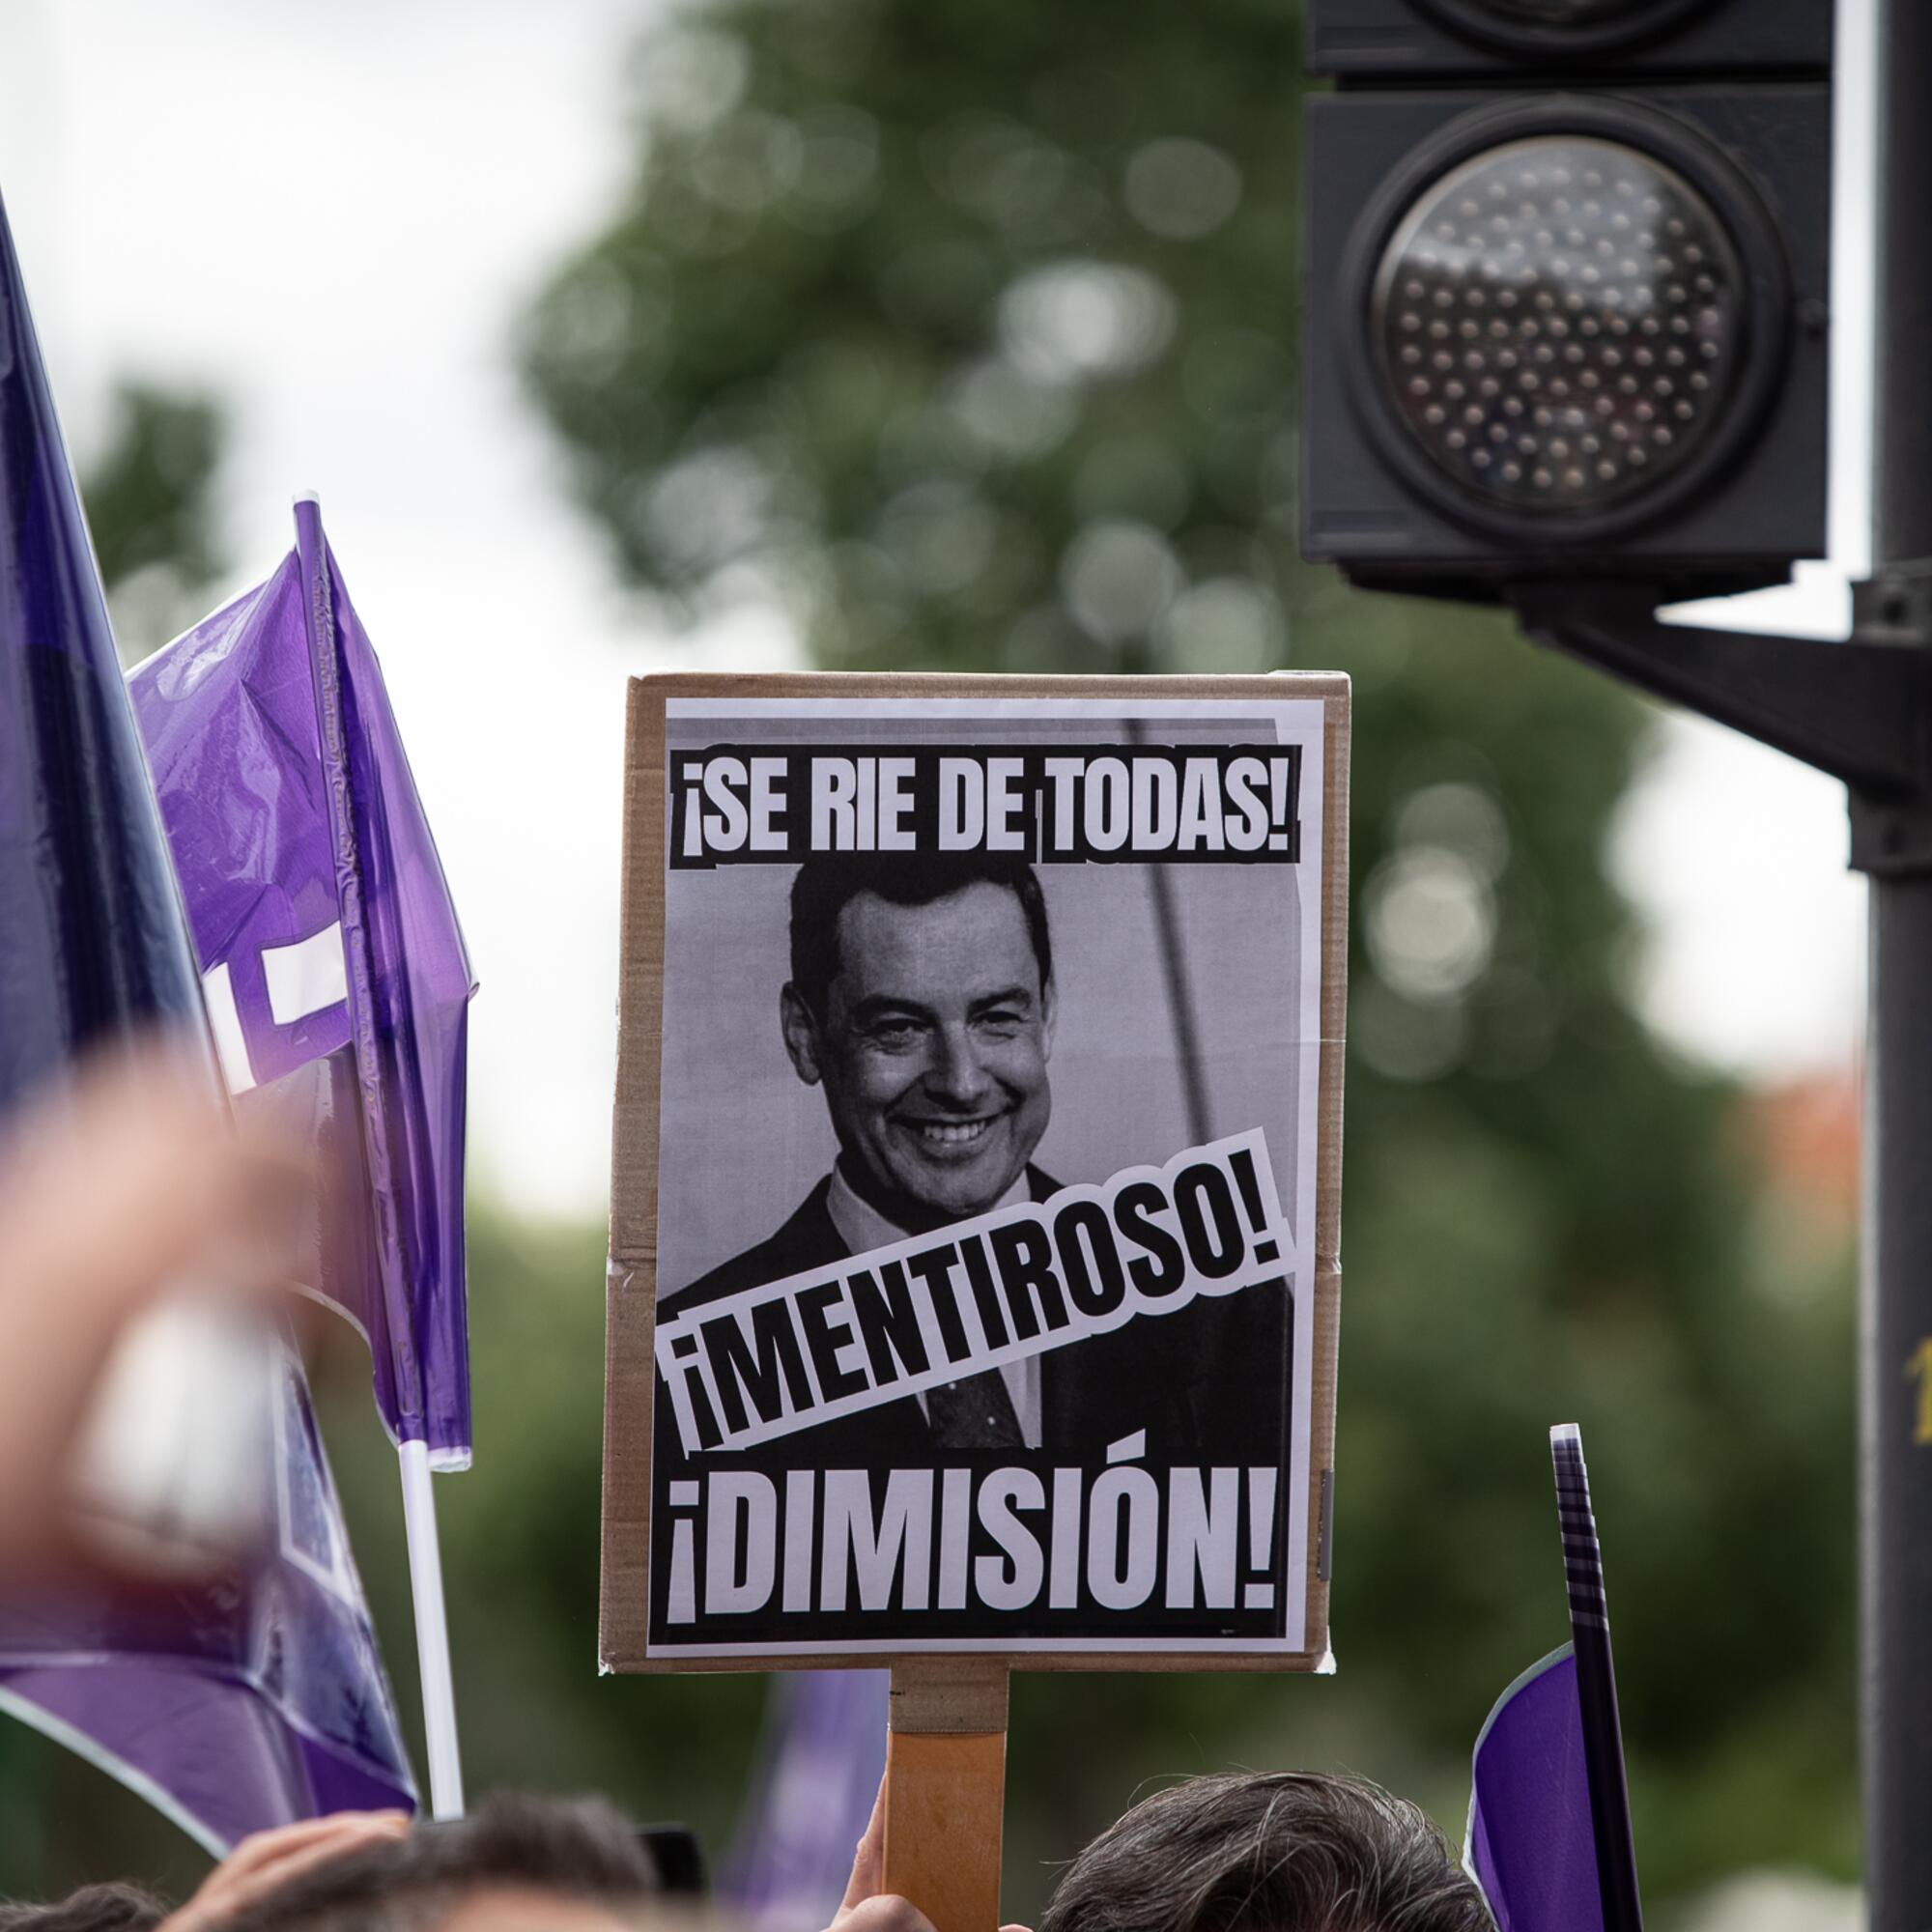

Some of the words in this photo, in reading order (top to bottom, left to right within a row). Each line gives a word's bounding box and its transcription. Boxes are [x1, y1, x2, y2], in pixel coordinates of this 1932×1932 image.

[682, 755, 788, 857] ¡SE
[810, 756, 917, 851] RIE
[937, 756, 1026, 851] DE
[1044, 755, 1290, 852] TODAS!
[673, 1148, 1281, 1450] ¡MENTIROSO!
[667, 1429, 1278, 1625] ¡DIMISIÓN!
